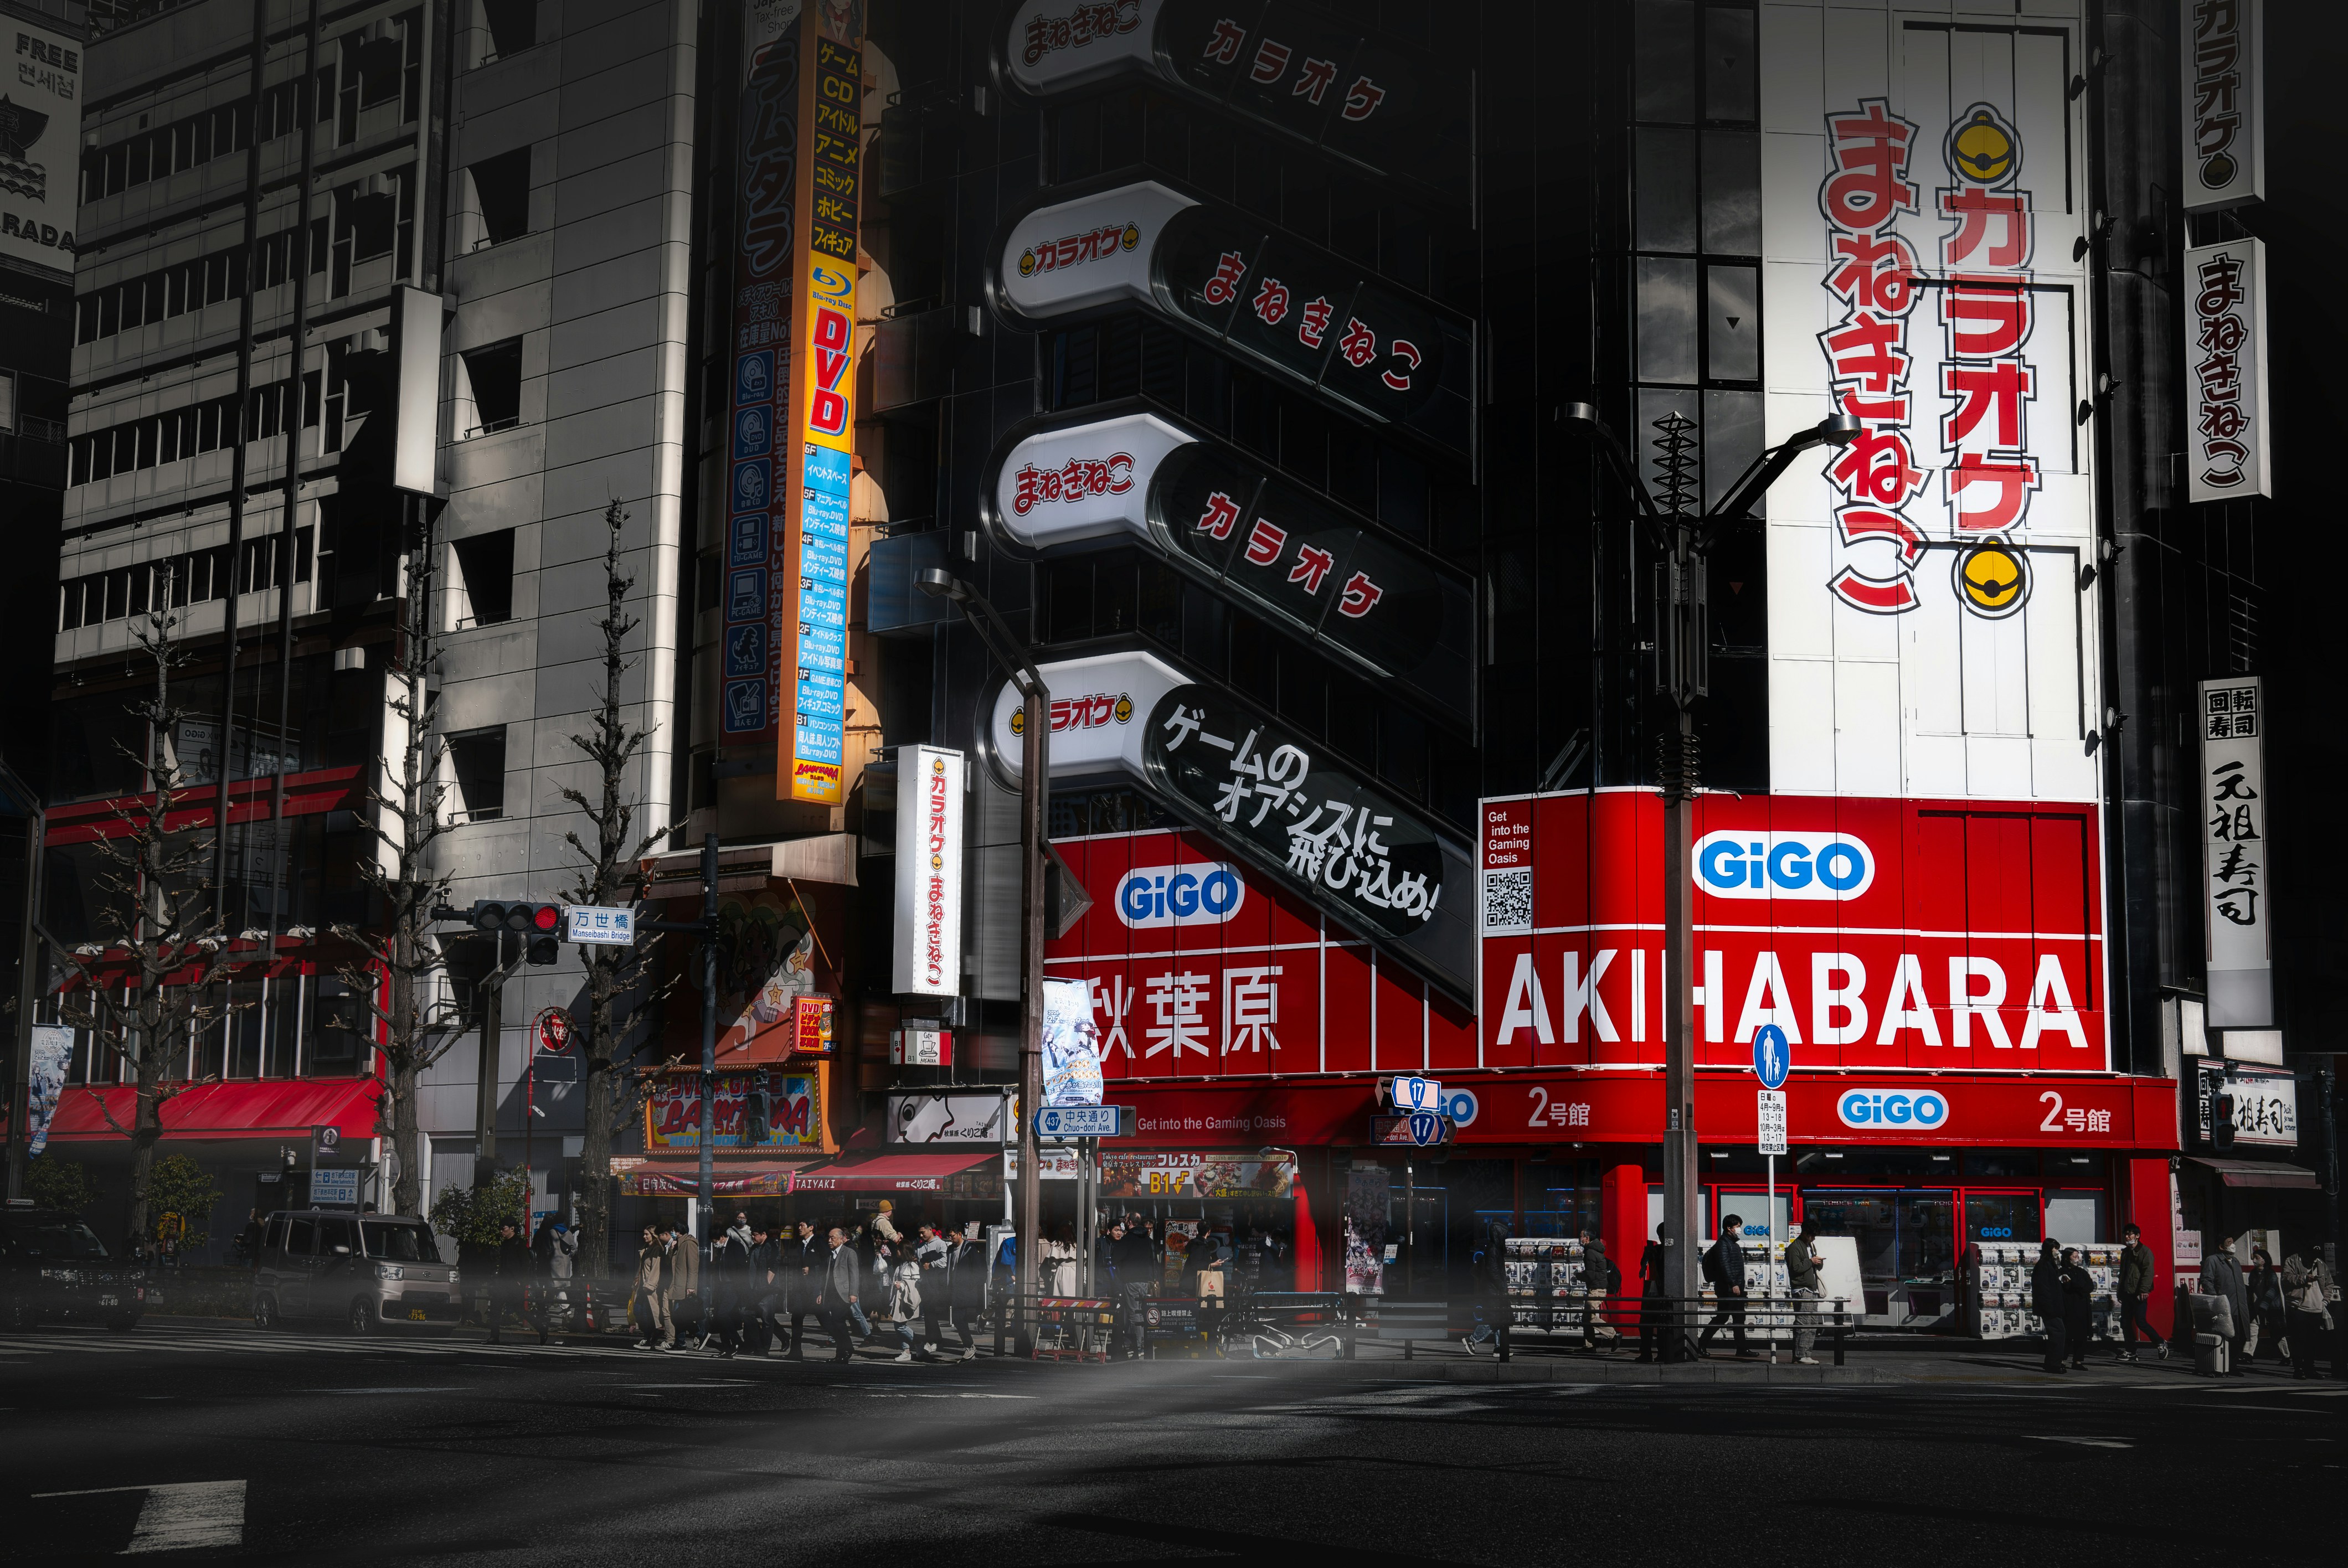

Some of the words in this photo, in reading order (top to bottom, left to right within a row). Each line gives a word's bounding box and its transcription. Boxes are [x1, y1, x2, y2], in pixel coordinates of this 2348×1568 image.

[755, 5, 794, 24] Tax-free
[1022, 0, 1141, 67] まねきねこ
[16, 32, 78, 74] FREE
[821, 43, 858, 77] ゲーム
[1203, 18, 1386, 122] カラオケ
[2192, 0, 2241, 160] カラオケ
[823, 76, 853, 104] CD
[818, 104, 858, 136] アイドル
[741, 37, 799, 277] ラムタラ
[816, 133, 858, 164] アニメ
[816, 166, 854, 195] コミック
[817, 196, 853, 222] ホビー
[0, 212, 76, 254] RADA
[815, 226, 853, 256] フィギュア
[1034, 224, 1125, 274] カラオケ
[812, 291, 836, 307] Blu-ray
[837, 299, 852, 311] Disc
[1204, 251, 1422, 391] まねきねこ
[1817, 97, 1932, 616] まねきねこ
[1935, 187, 2042, 540] カラオケ
[2195, 251, 2250, 489] まねきねこ
[809, 306, 851, 437] DVD
[742, 391, 764, 400] Blu-ray
[805, 443, 816, 454] 6F
[804, 489, 815, 499] 5F
[1012, 452, 1135, 516] まねきねこ
[802, 534, 812, 544] 4F
[1196, 490, 1384, 619] カラオケ
[801, 578, 812, 589] 3F
[799, 623, 810, 635] 2F
[799, 669, 809, 679] 1F
[796, 715, 807, 726] B1
[1049, 693, 1116, 732] ラオケ
[1163, 703, 1309, 791] ゲームの
[929, 773, 948, 855] カラオケ
[1214, 775, 1393, 856] オアシスに
[1489, 812, 1507, 822] Get
[1489, 838, 1530, 850] Gaming
[1491, 826, 1510, 836] into
[1513, 824, 1530, 834] the
[2209, 761, 2261, 926] 元祖寿司
[1489, 853, 1518, 864] Oasis
[1700, 839, 1866, 891] GiGO
[1122, 869, 1238, 920] GiGO
[576, 911, 629, 929] 万世橋
[926, 873, 945, 987] まねきねこ
[573, 929, 610, 940] Manseibashi
[611, 931, 630, 941] Bridge
[801, 1003, 820, 1014] DVD
[1496, 947, 2089, 1050] AKIHABARA
[1090, 966, 1283, 1062] 秋葉原
[1412, 1082, 1424, 1101] 17
[1065, 1111, 1109, 1122] 中央通り
[1528, 1086, 1590, 1128] 2号館
[1842, 1094, 1943, 1125] GiGO
[2040, 1091, 2112, 1133] 2号館
[960, 1127, 988, 1139] くりこ庵
[1046, 1116, 1060, 1127] 437
[1064, 1123, 1095, 1133] Chuo-dori
[1098, 1123, 1111, 1132] Ave.
[1138, 1117, 1157, 1131] Get
[1160, 1117, 1181, 1131] into
[1183, 1116, 1202, 1130] the
[1206, 1115, 1250, 1132] Gaming
[1254, 1115, 1286, 1129] Oasis
[1376, 1120, 1408, 1133] 中央通り
[1413, 1118, 1430, 1137] 17
[1157, 1154, 1201, 1167] フレスカ
[796, 1179, 835, 1189] TAIYAKI
[911, 1179, 936, 1189] くりこ庵
[1150, 1172, 1170, 1194] B1
[1980, 1227, 2012, 1238] GiGO
